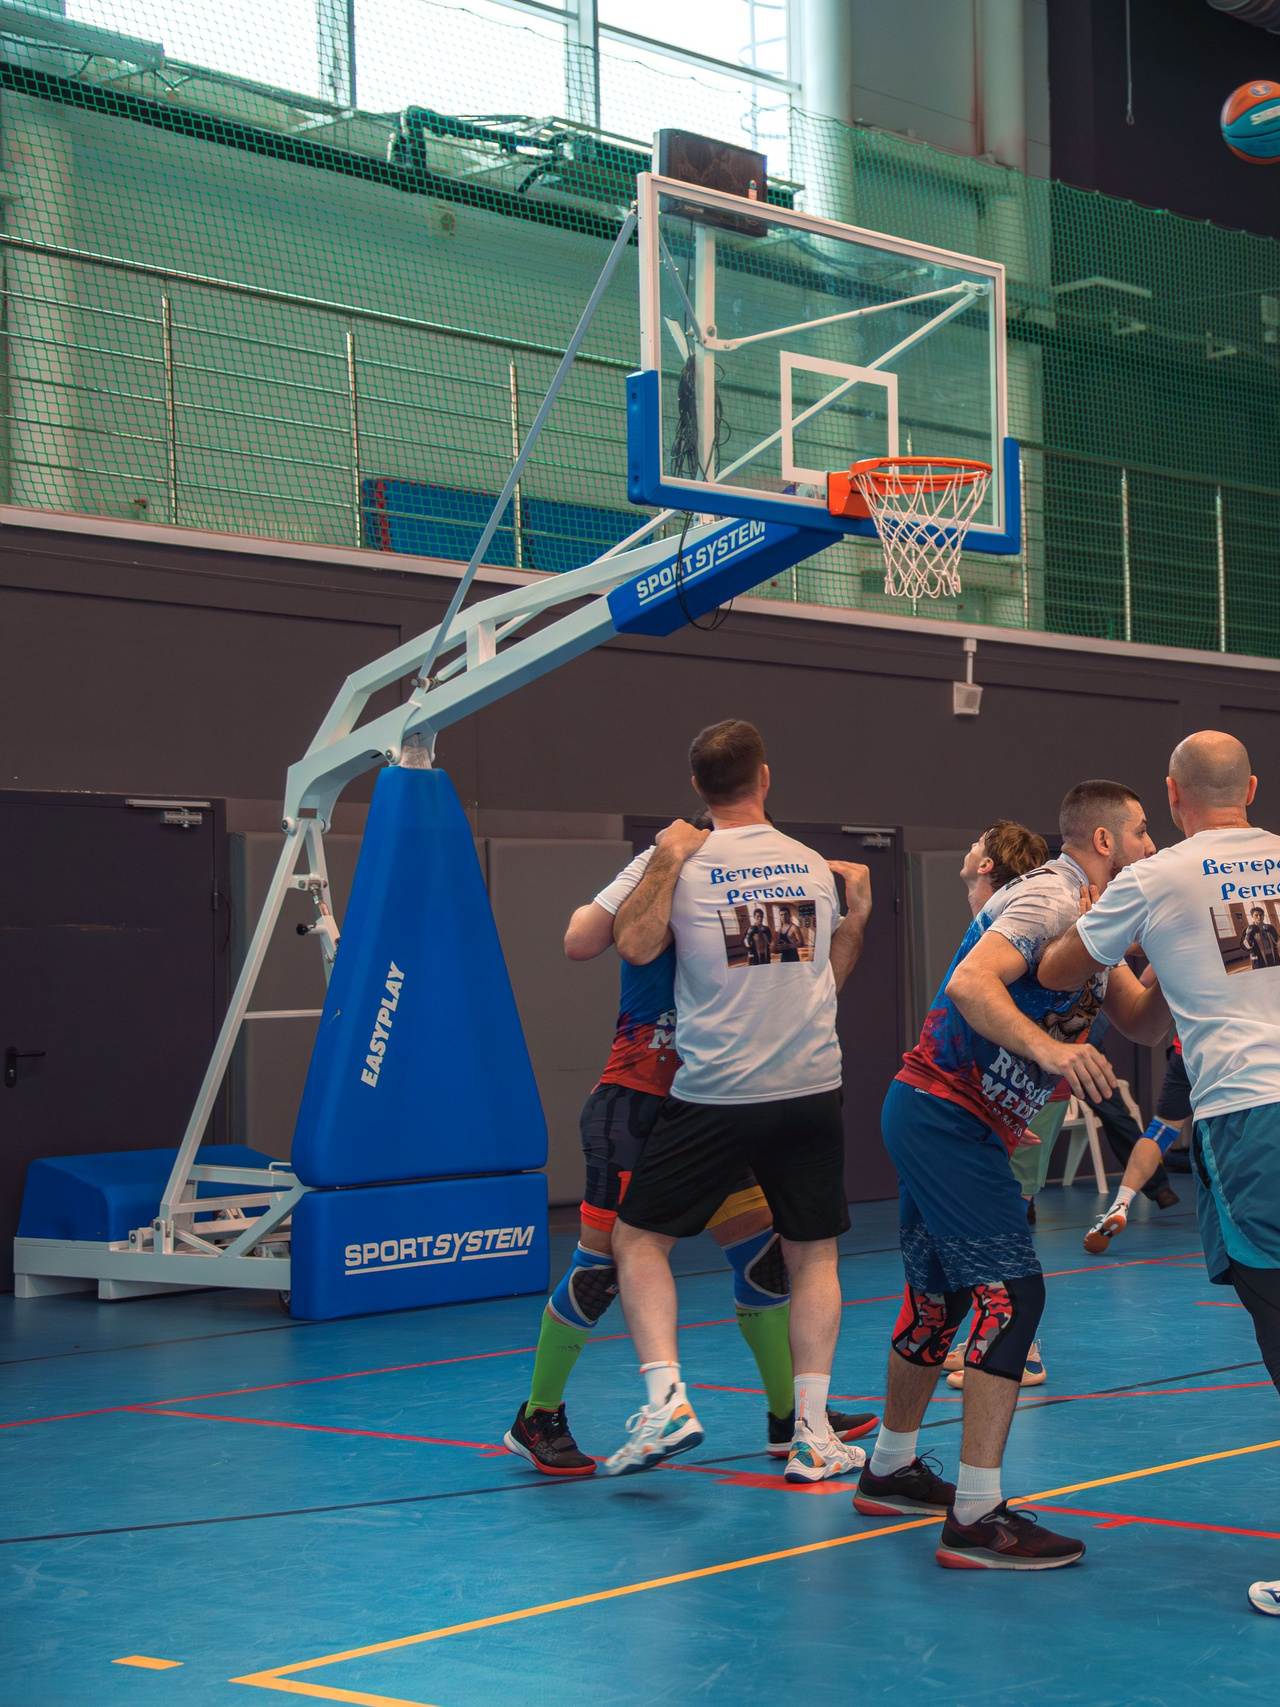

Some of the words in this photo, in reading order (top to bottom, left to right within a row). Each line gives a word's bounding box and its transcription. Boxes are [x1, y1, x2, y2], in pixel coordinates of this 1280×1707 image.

[710, 863, 809, 885] Ветераны
[726, 885, 807, 905] Регбола
[360, 960, 406, 1088] EASYPLAY
[344, 1225, 535, 1275] SPORTSYSTEM
